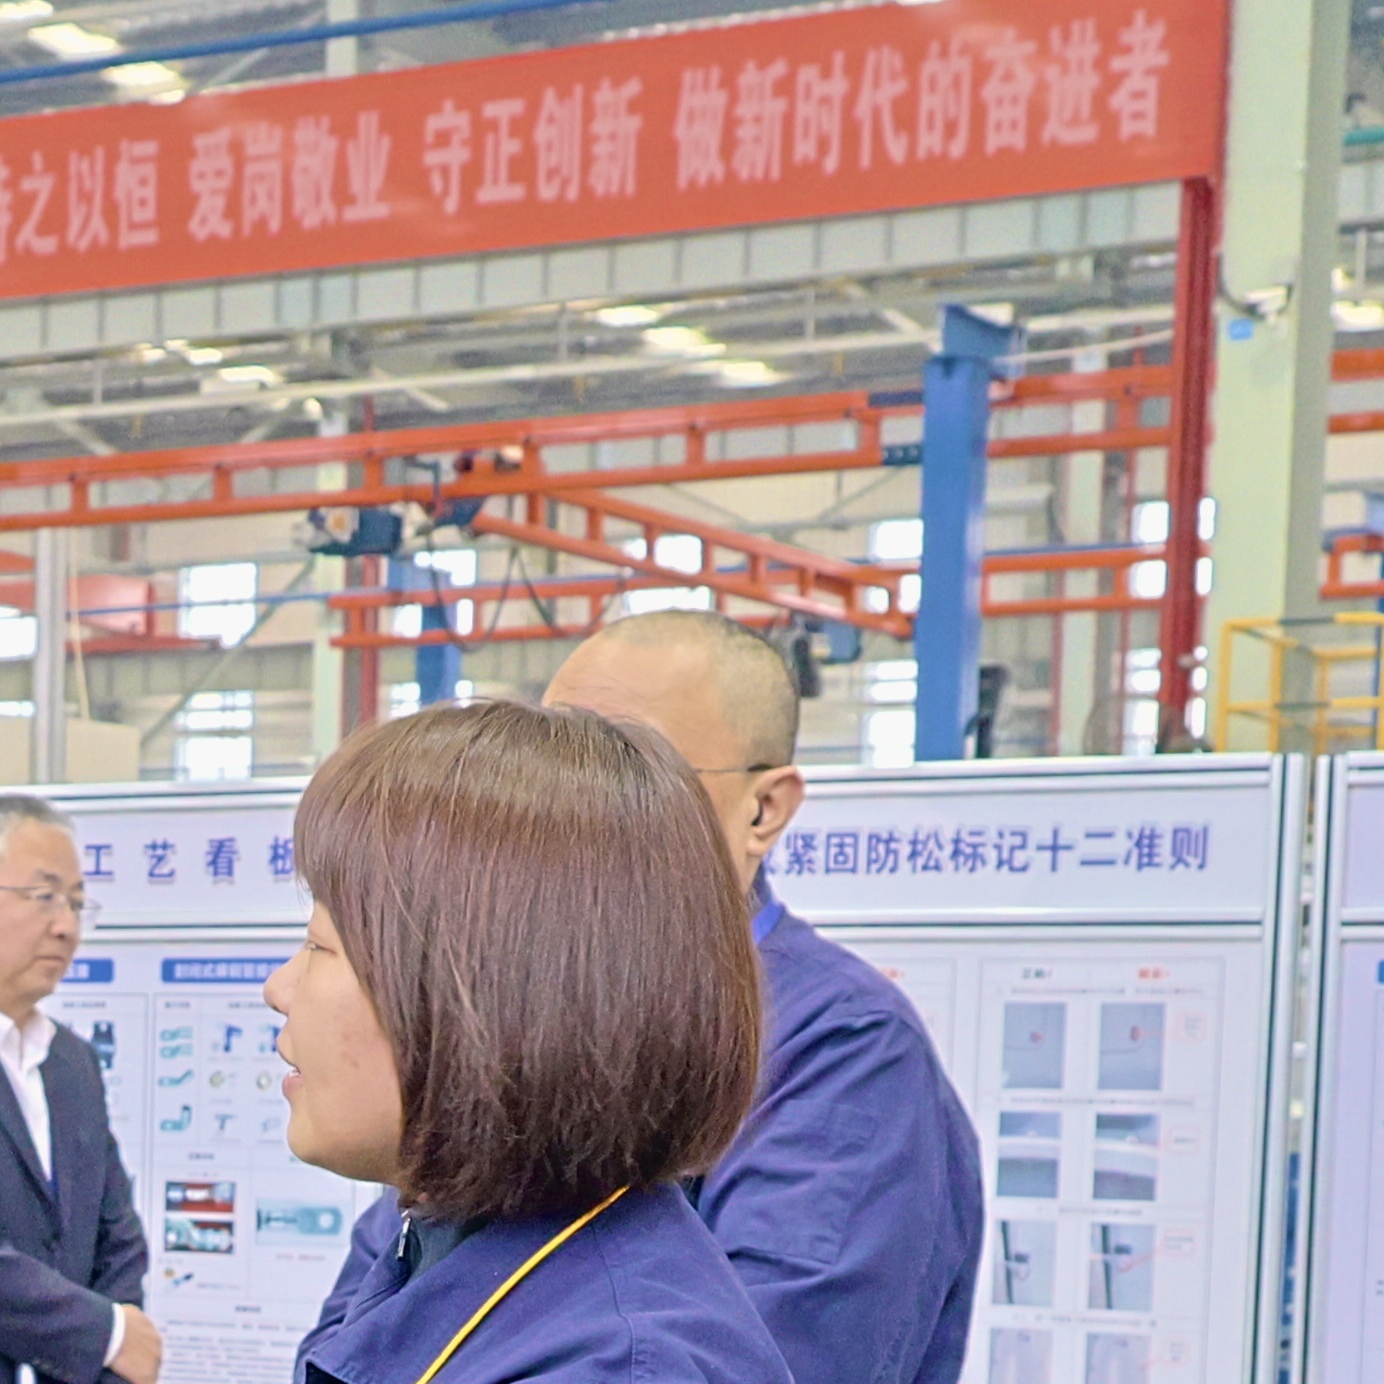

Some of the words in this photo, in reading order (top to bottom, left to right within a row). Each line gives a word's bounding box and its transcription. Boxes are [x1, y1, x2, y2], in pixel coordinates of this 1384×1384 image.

[187, 110, 392, 243] 爱岗敬业
[423, 76, 644, 215] 守正创新
[673, 14, 1171, 190] 做新时代的奋进者
[764, 823, 1211, 876] 紧固防松标记十二准则
